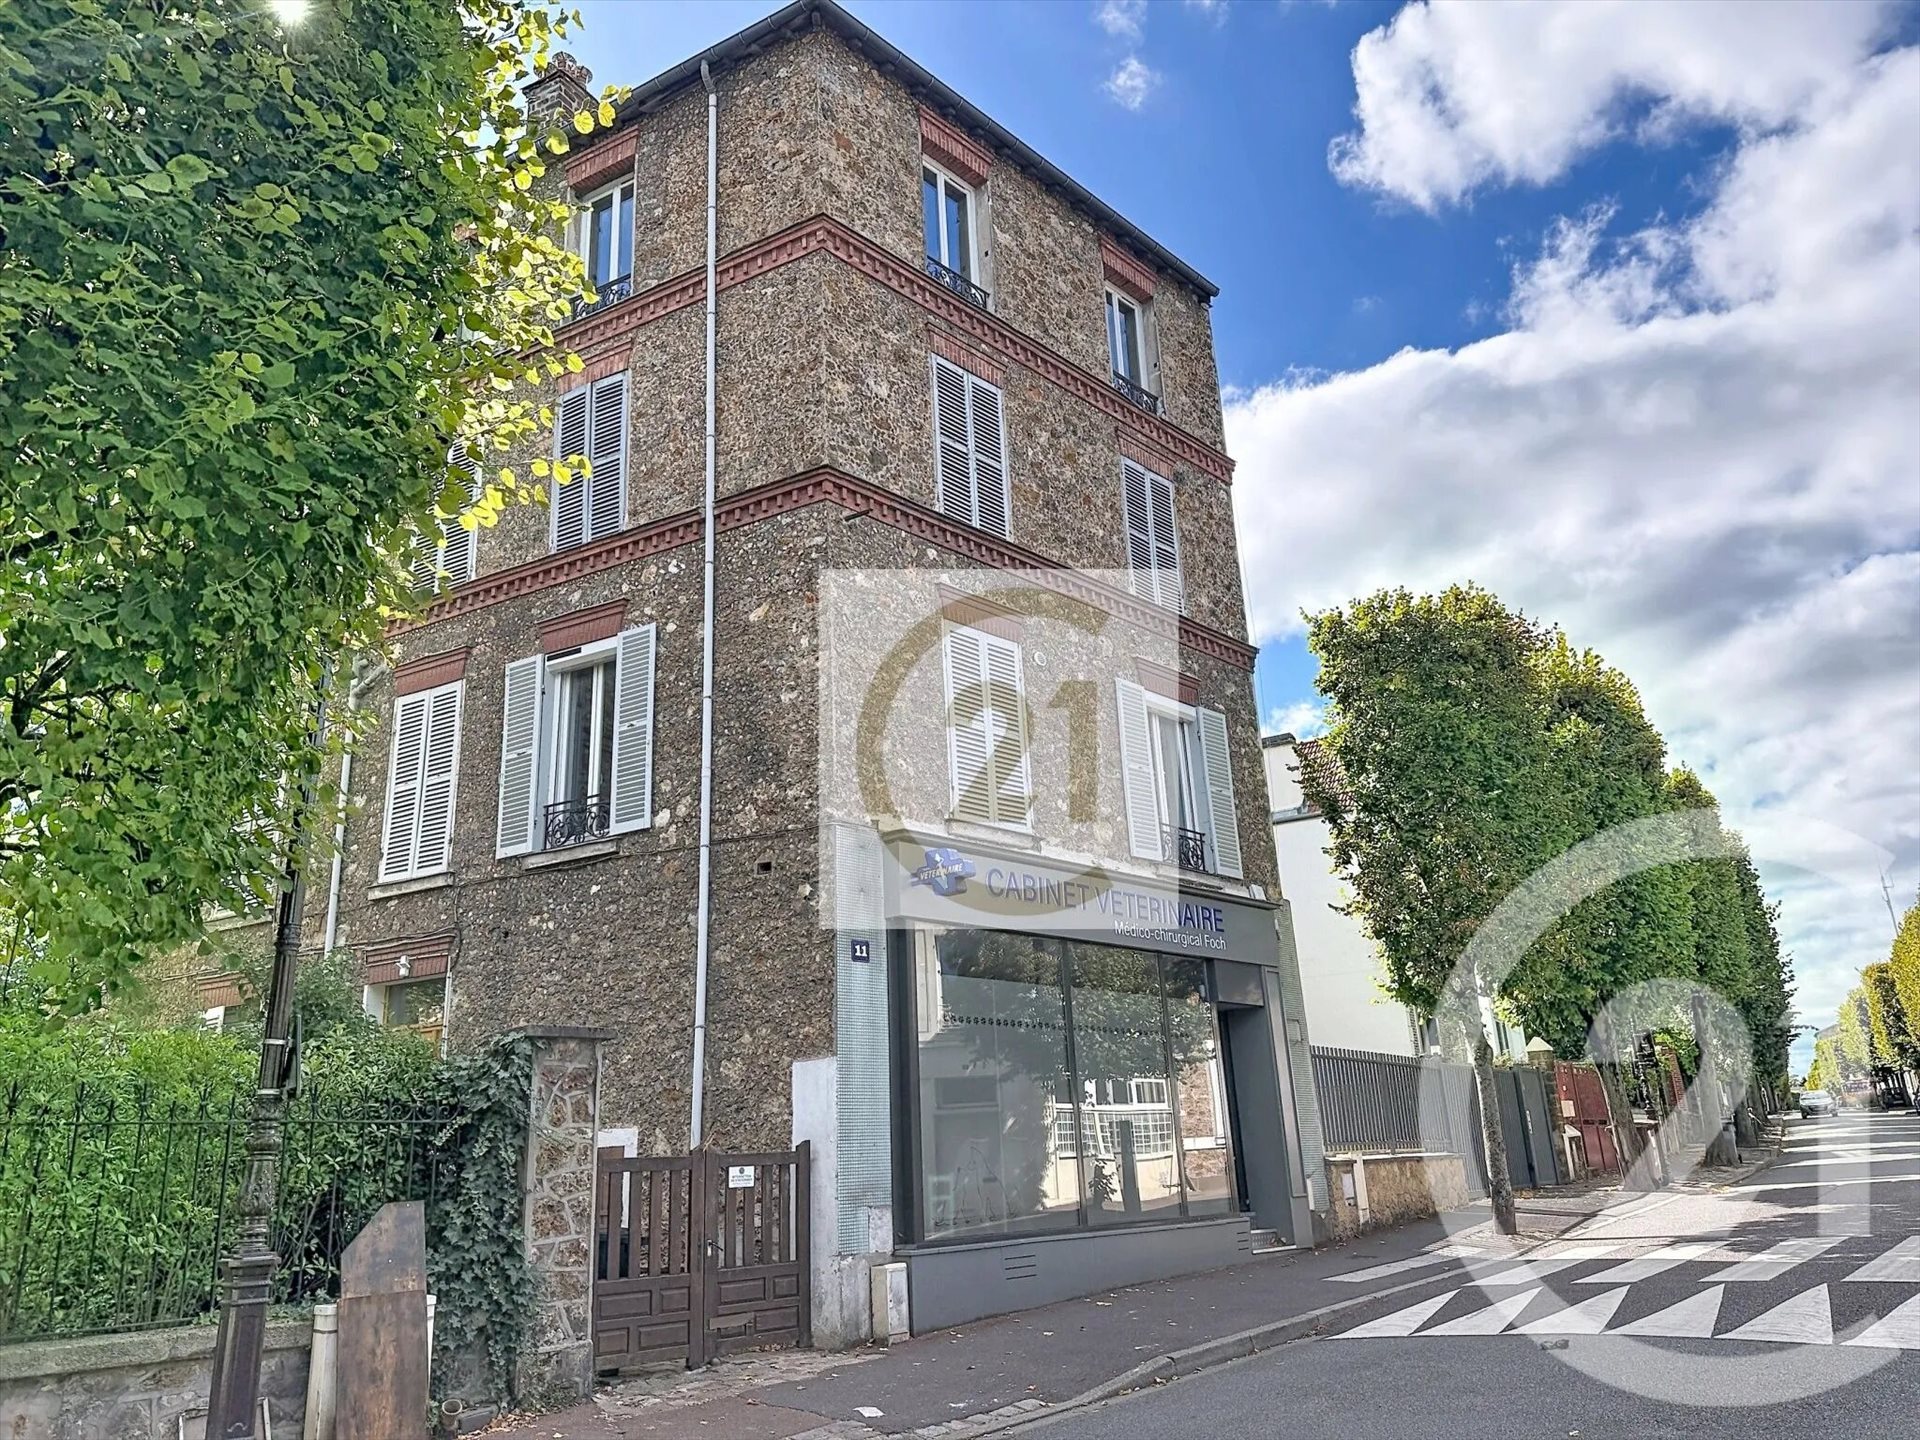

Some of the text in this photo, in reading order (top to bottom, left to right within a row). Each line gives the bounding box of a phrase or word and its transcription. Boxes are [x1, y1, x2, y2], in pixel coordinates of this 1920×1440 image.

[986, 868, 1225, 933] CABINET VETERINAIRE
[1114, 920, 1227, 950] Médico-chirurgical Foch
[855, 944, 868, 957] 11
